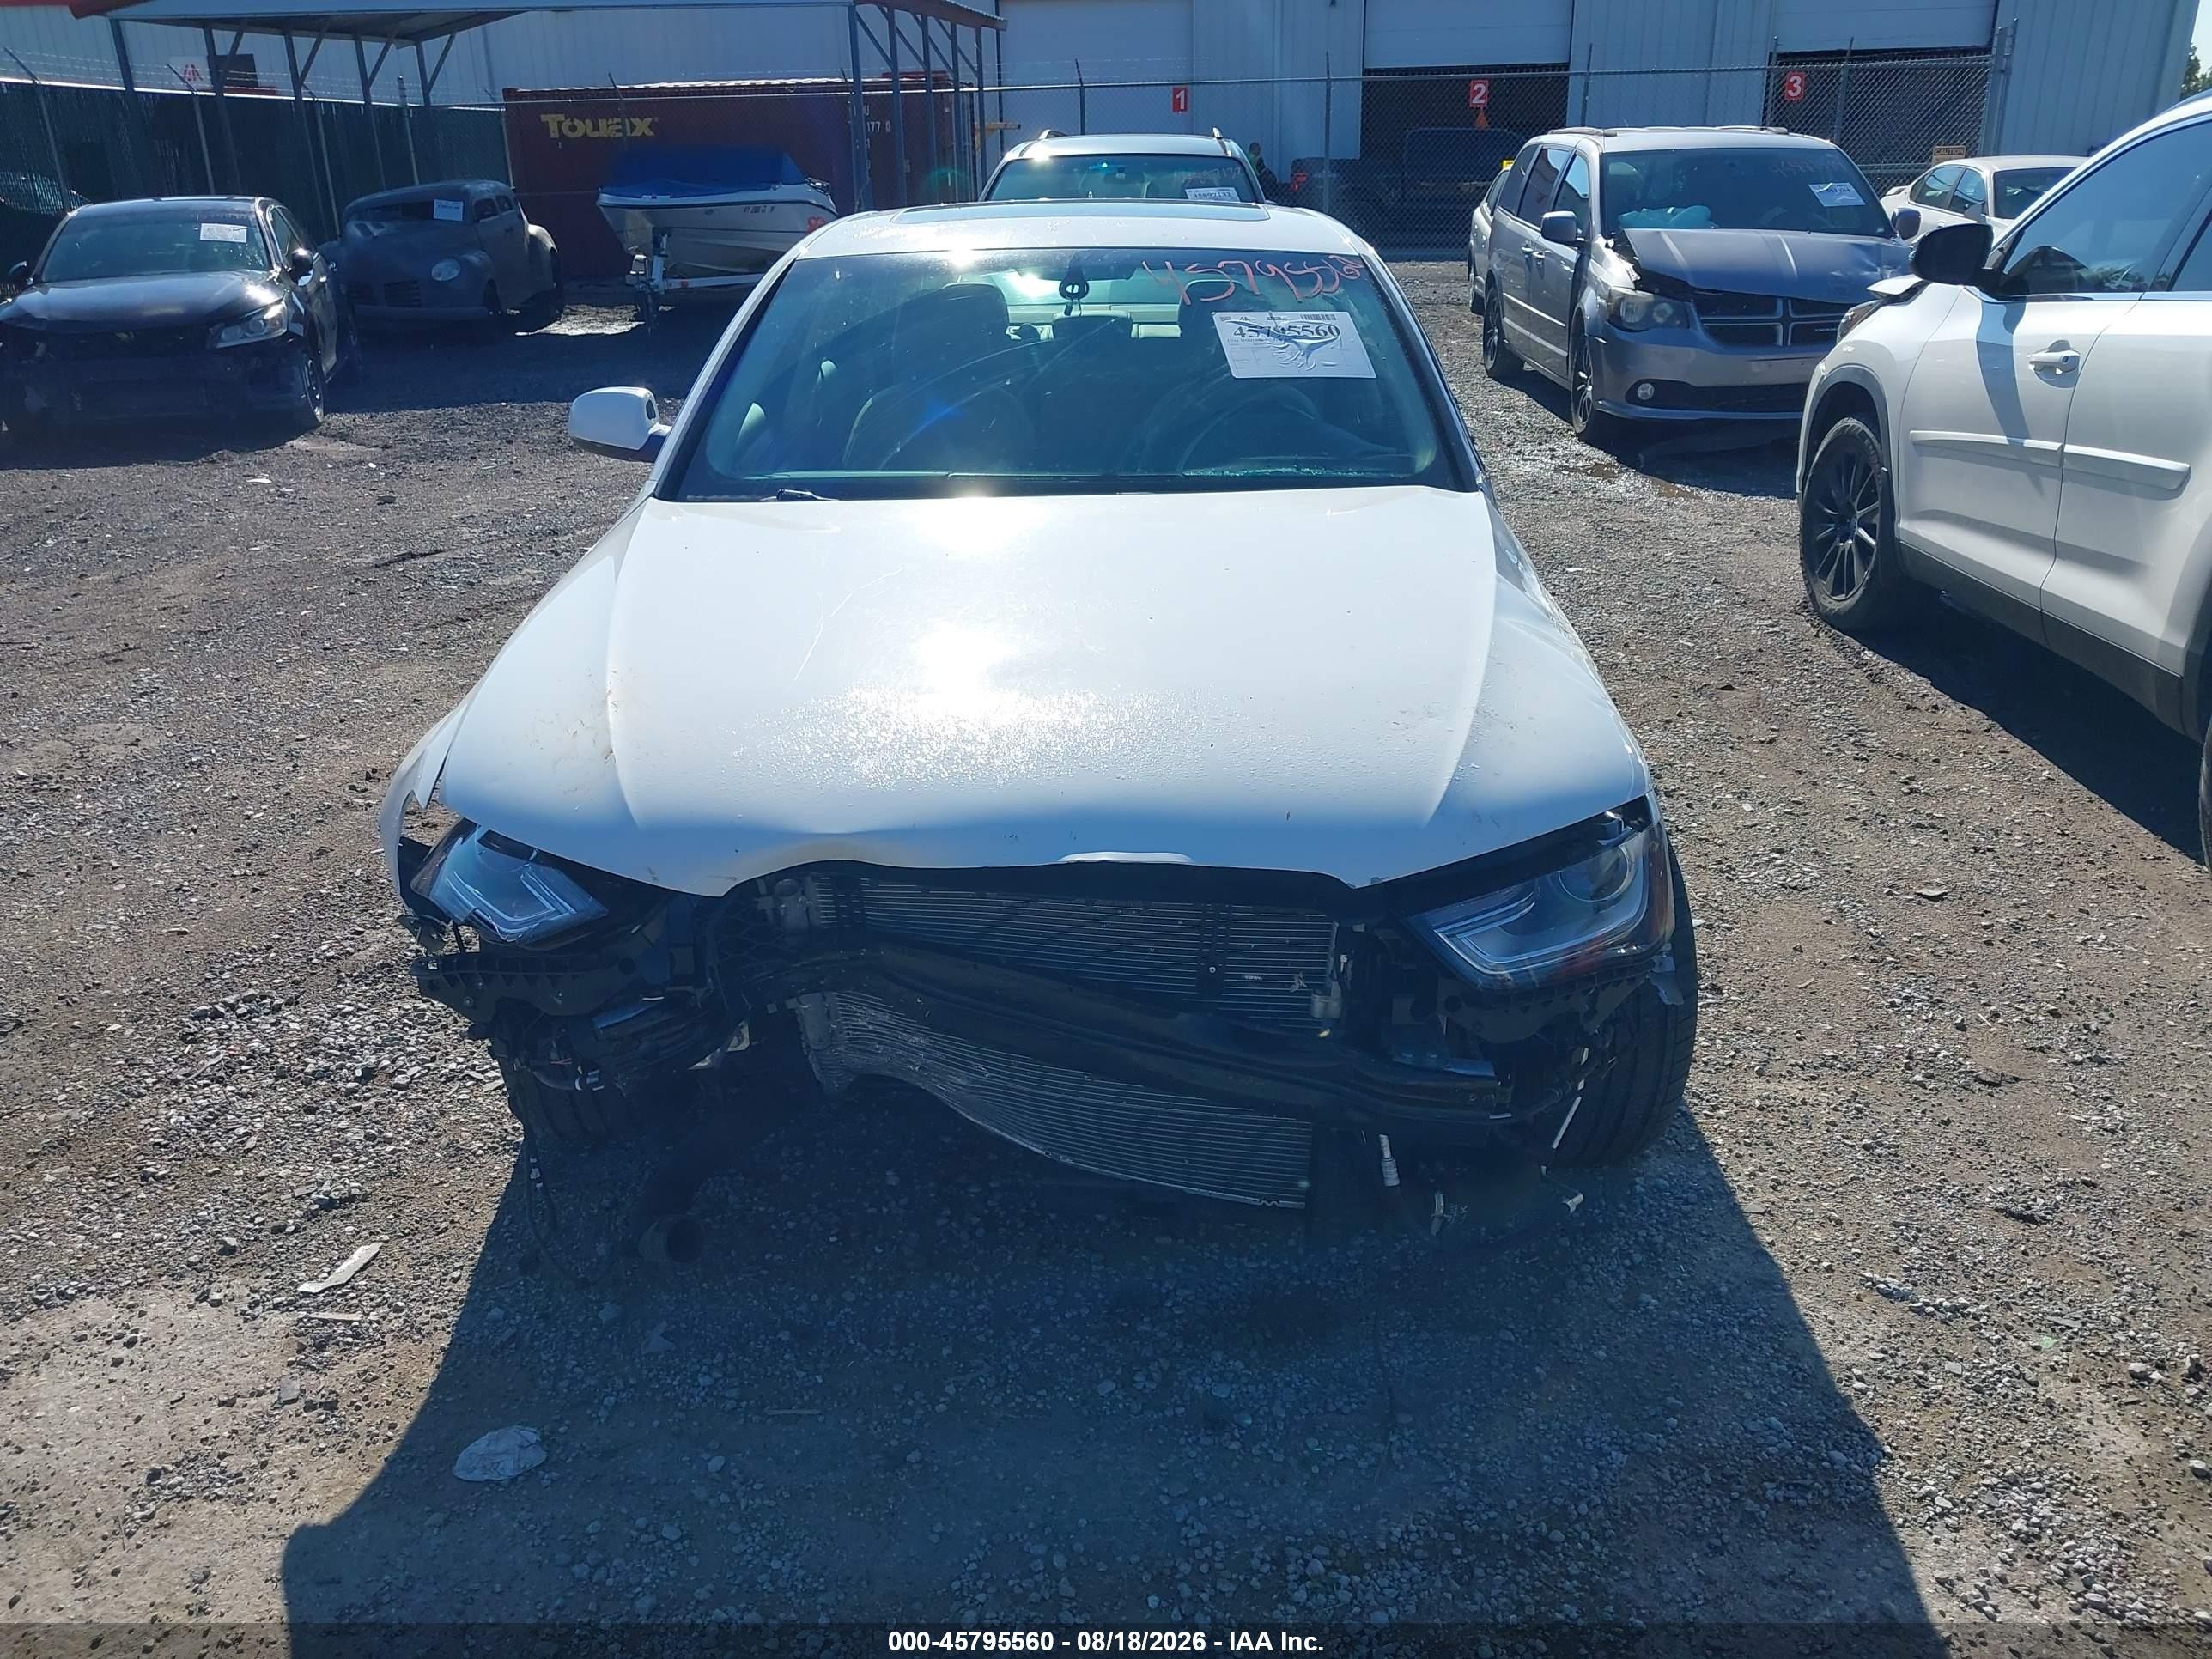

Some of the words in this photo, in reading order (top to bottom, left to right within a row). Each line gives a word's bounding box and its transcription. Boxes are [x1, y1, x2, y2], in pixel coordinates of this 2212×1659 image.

[1472, 83, 1486, 104] 2
[1788, 75, 1802, 97] 3
[1176, 89, 1185, 111] 1
